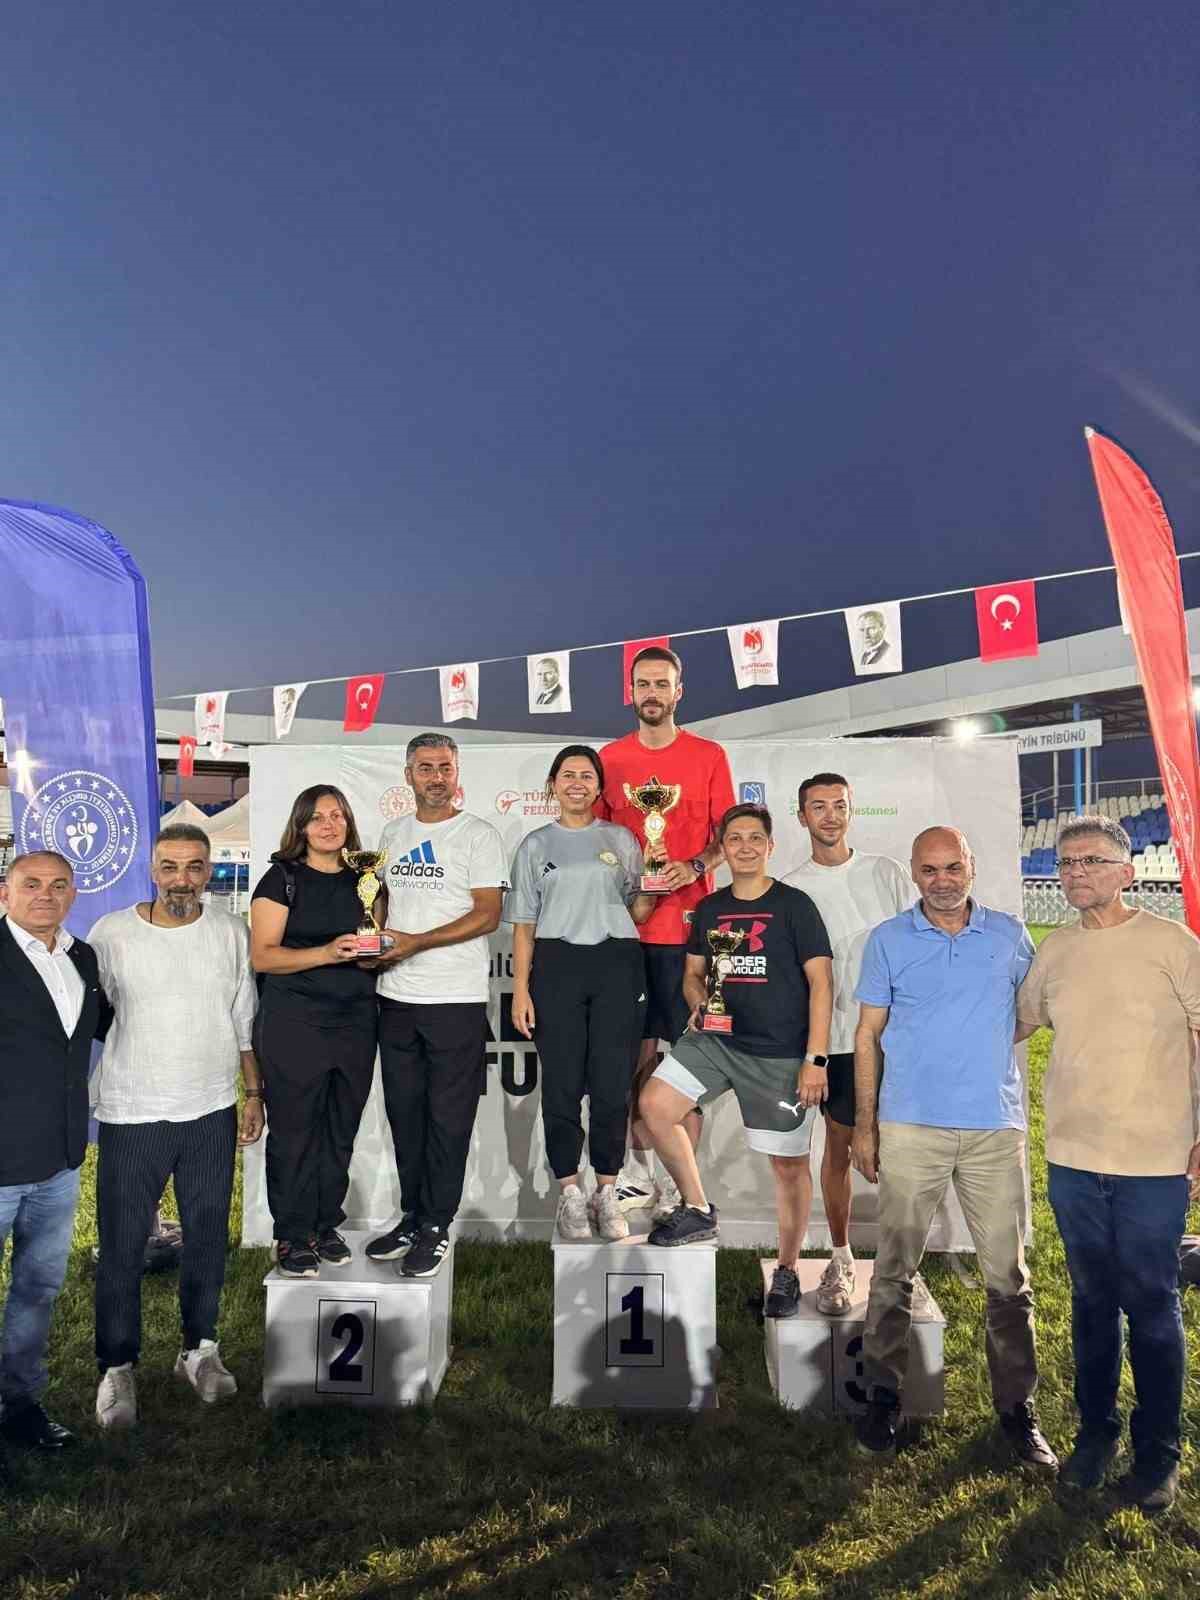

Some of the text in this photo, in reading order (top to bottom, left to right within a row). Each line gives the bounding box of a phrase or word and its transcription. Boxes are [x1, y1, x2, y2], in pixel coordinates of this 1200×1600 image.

[1040, 729, 1086, 746] TRİBÜNÜ
[391, 862, 445, 878] adidas
[620, 1286, 654, 1354] 1
[329, 1313, 364, 1381] 2
